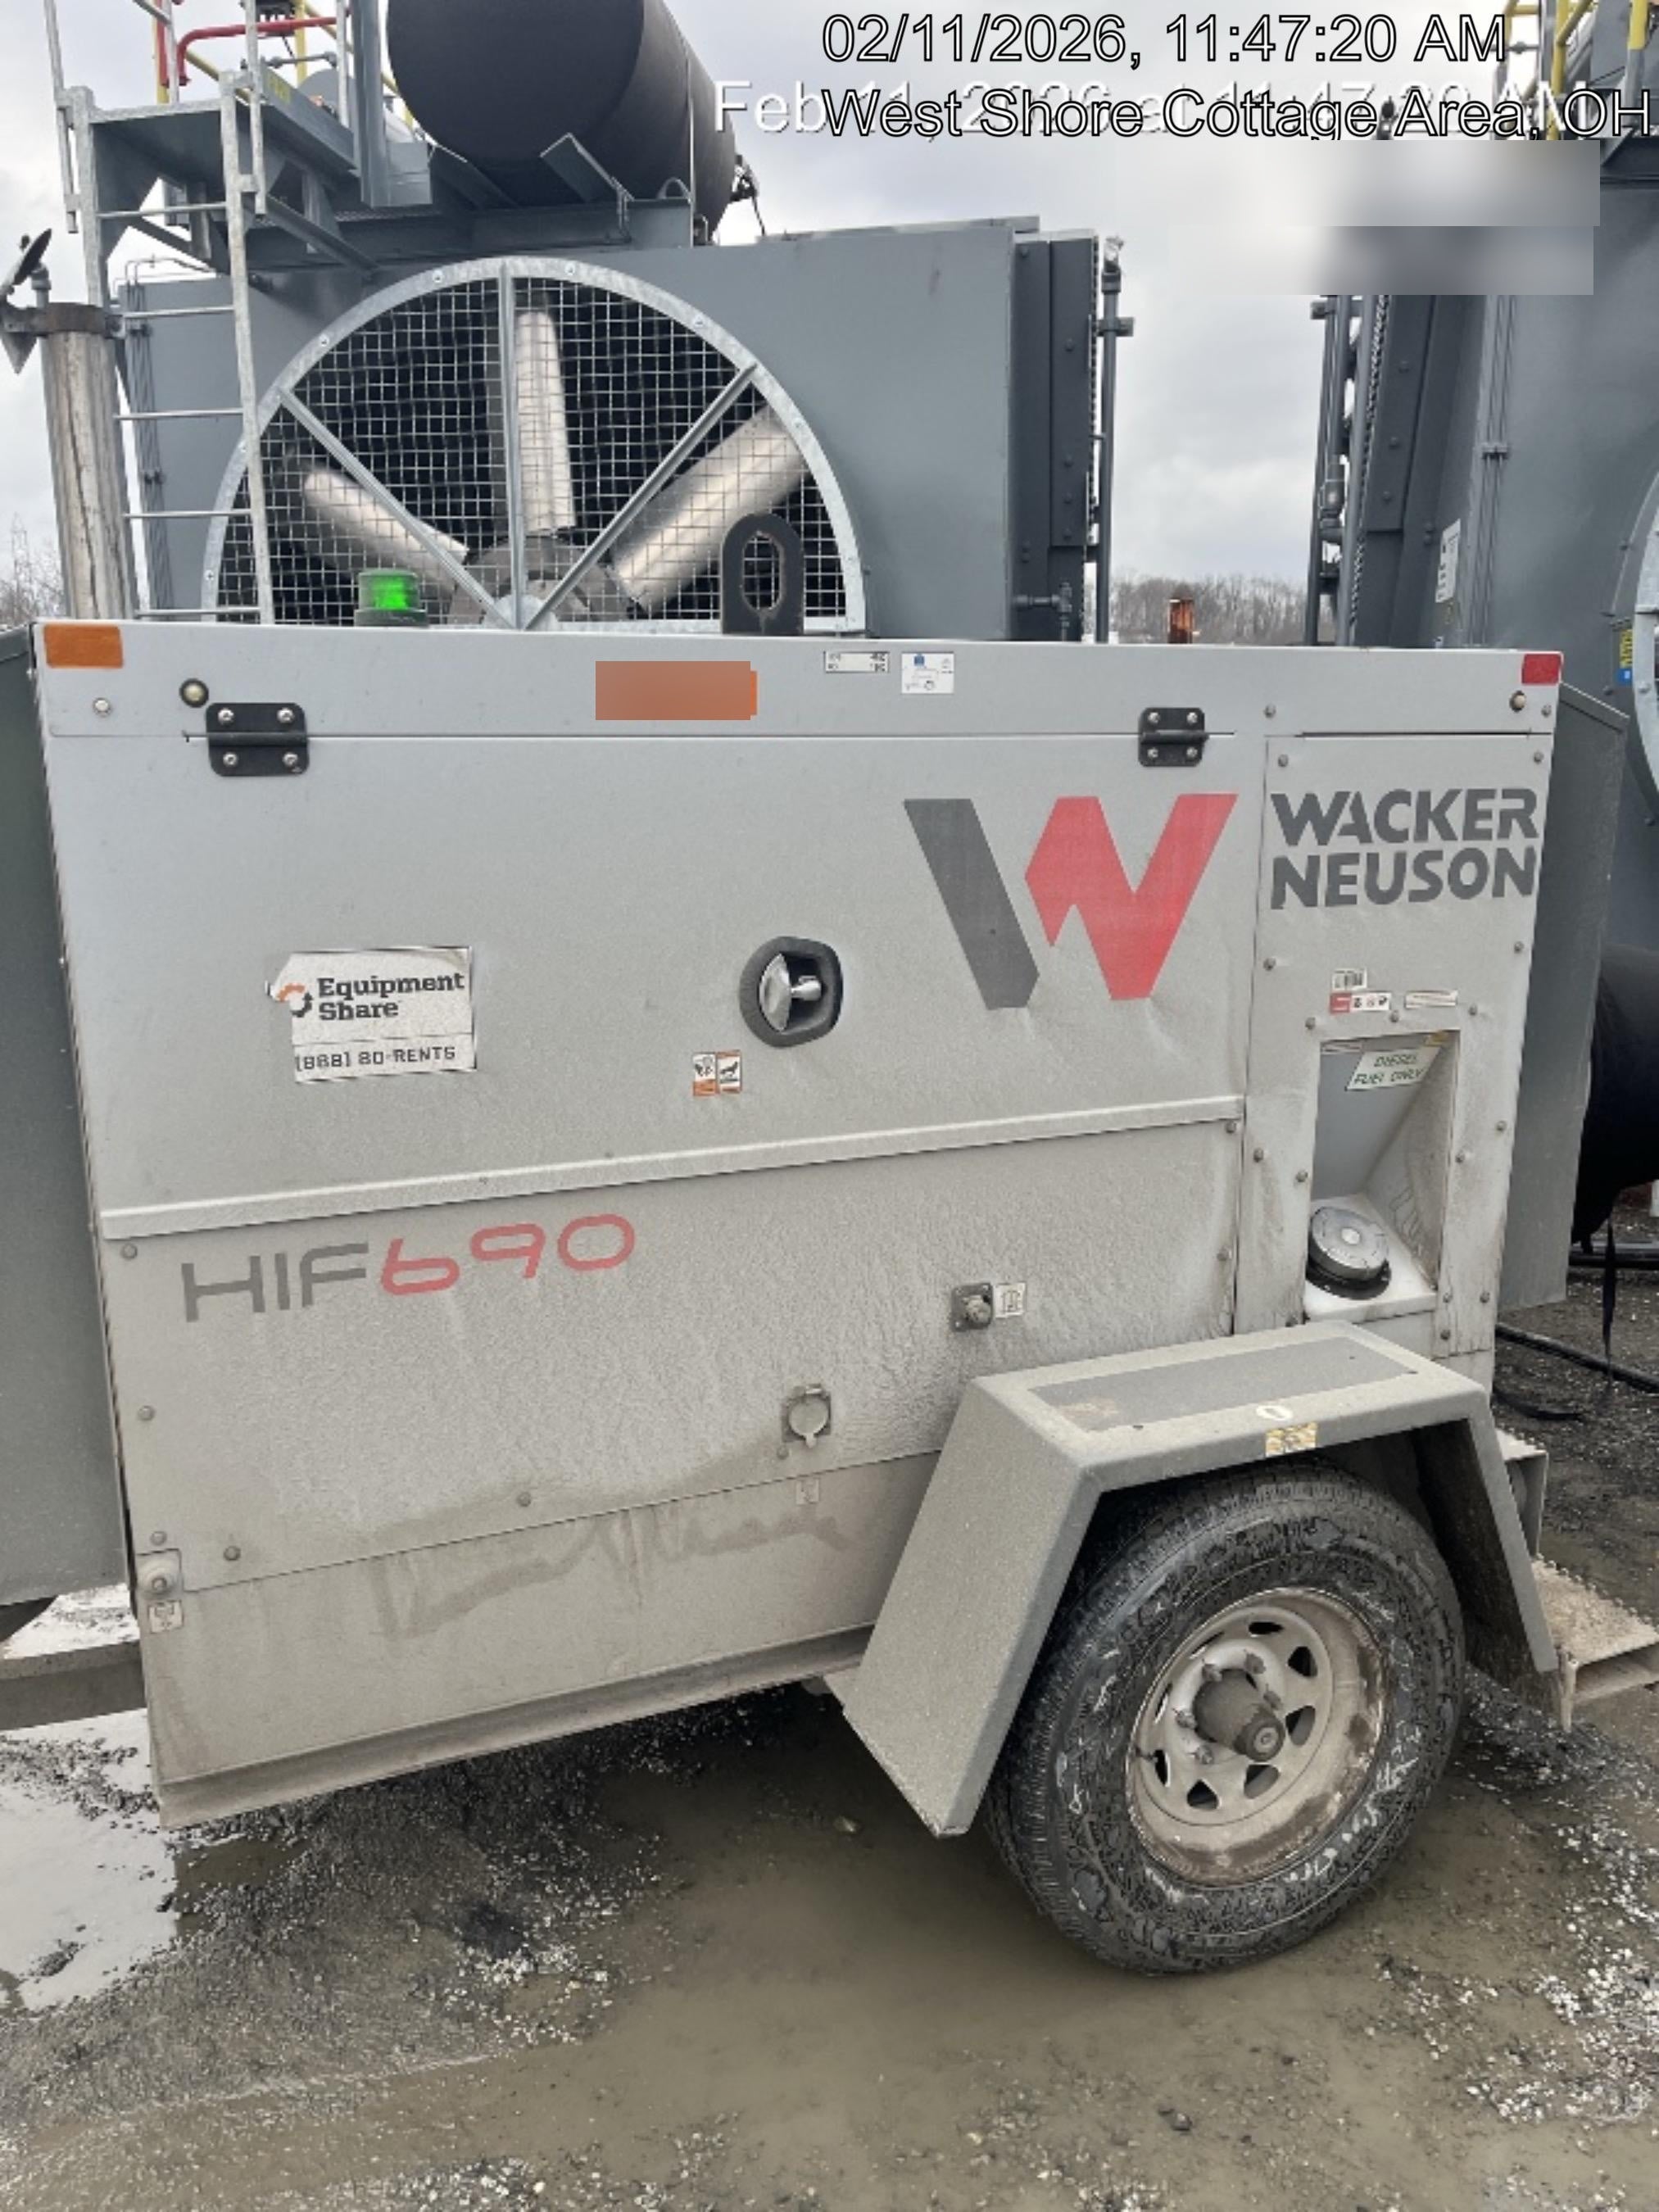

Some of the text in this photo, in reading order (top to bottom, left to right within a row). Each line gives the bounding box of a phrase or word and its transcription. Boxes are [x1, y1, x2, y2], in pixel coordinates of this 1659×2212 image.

[1270, 788, 1539, 846] WACKER
[1270, 844, 1538, 910] NEUSON
[316, 972, 465, 1001] Equipment
[318, 1001, 400, 1021] Share
